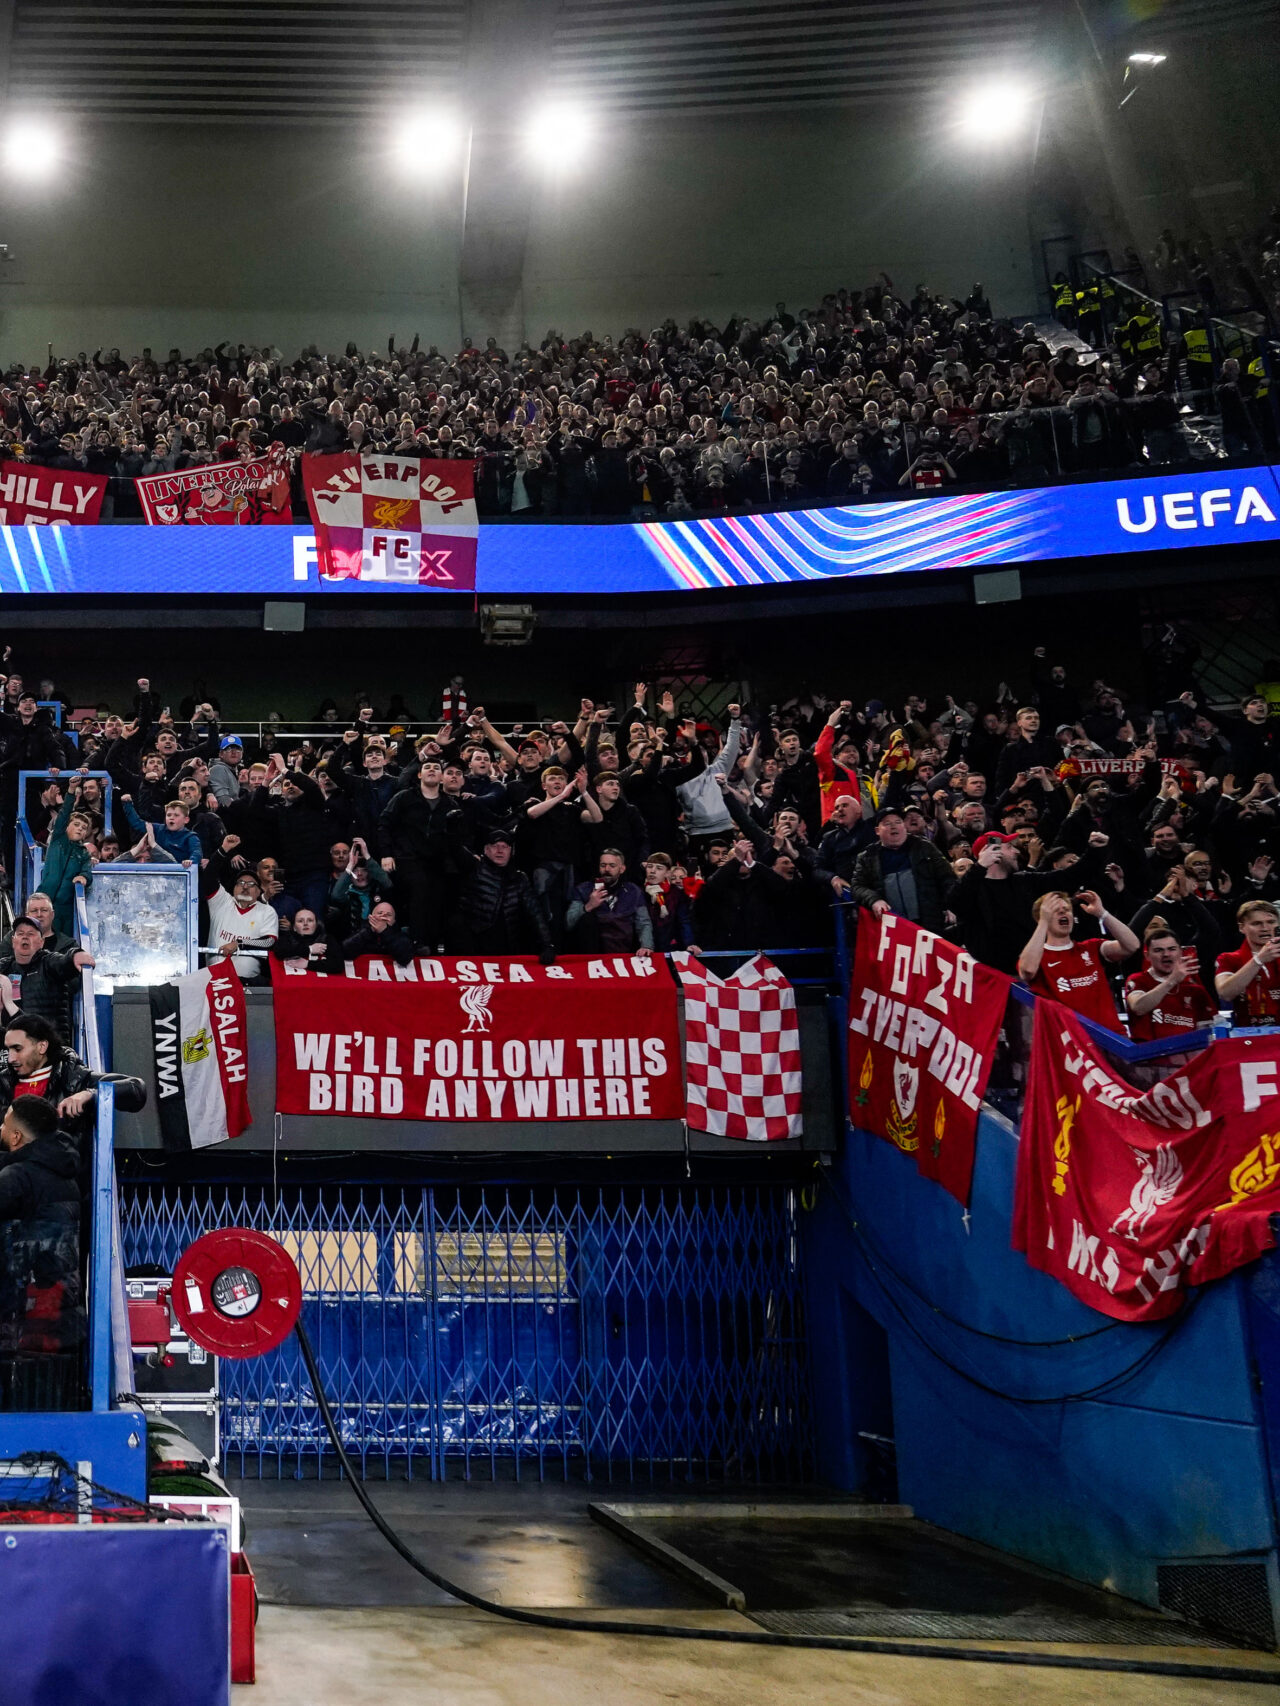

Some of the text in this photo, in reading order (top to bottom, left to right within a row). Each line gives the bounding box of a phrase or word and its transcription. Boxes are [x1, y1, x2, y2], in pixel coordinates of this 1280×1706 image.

[145, 463, 266, 503] LIVERPOO
[317, 462, 464, 515] LIVERPOOL
[1116, 486, 1277, 534] UEFA
[1080, 759, 1180, 776] LIVERPOL
[545, 965, 574, 979] &
[587, 956, 658, 978] AIR
[877, 914, 978, 1015] FORZA
[209, 976, 247, 1083] M.SALAH
[154, 1011, 180, 1099] YNWA
[293, 1032, 667, 1078] WE'LL FOLLOW THIS
[308, 1073, 652, 1119] BIRD ANYWHERE
